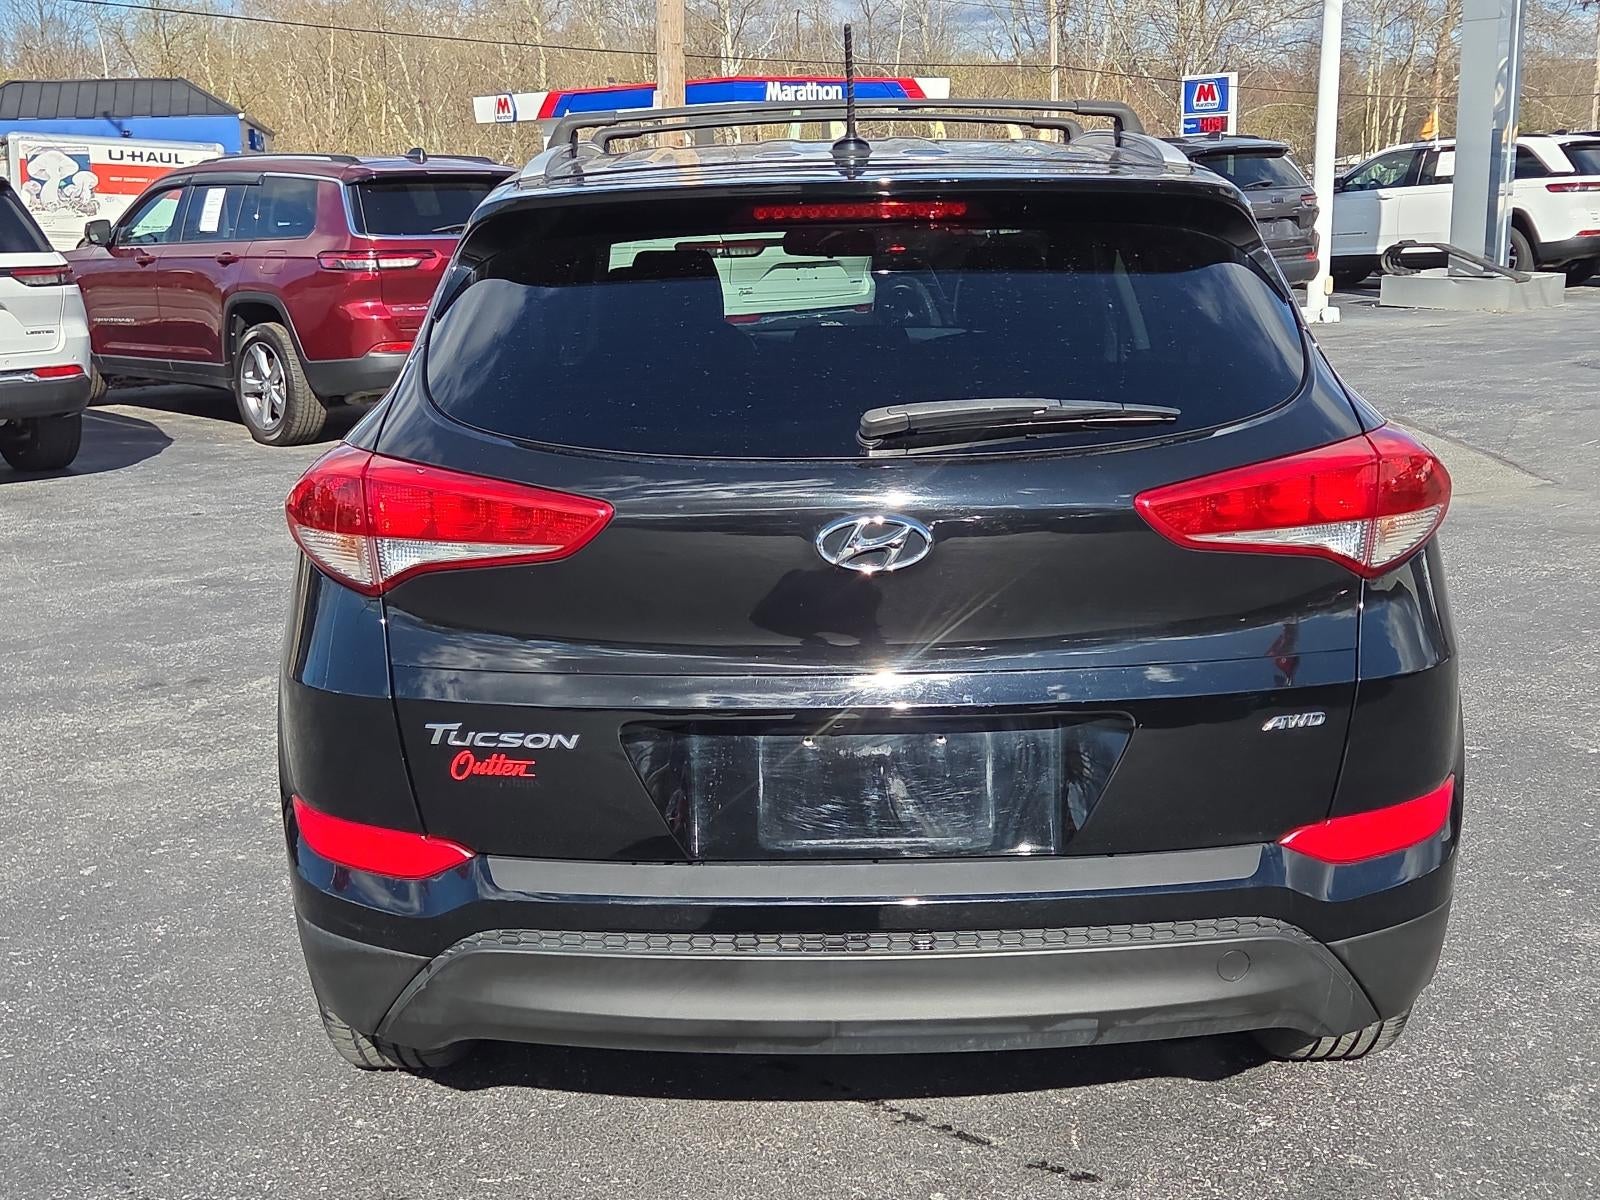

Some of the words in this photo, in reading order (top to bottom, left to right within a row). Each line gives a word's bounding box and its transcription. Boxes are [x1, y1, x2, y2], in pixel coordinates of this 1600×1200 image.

[766, 81, 843, 101] Marathon
[1196, 83, 1217, 102] M
[497, 97, 511, 115] M
[108, 149, 185, 165] U-HAUL
[1261, 711, 1326, 732] AWD
[424, 722, 580, 750] TUCSON
[450, 750, 536, 781] Outten
